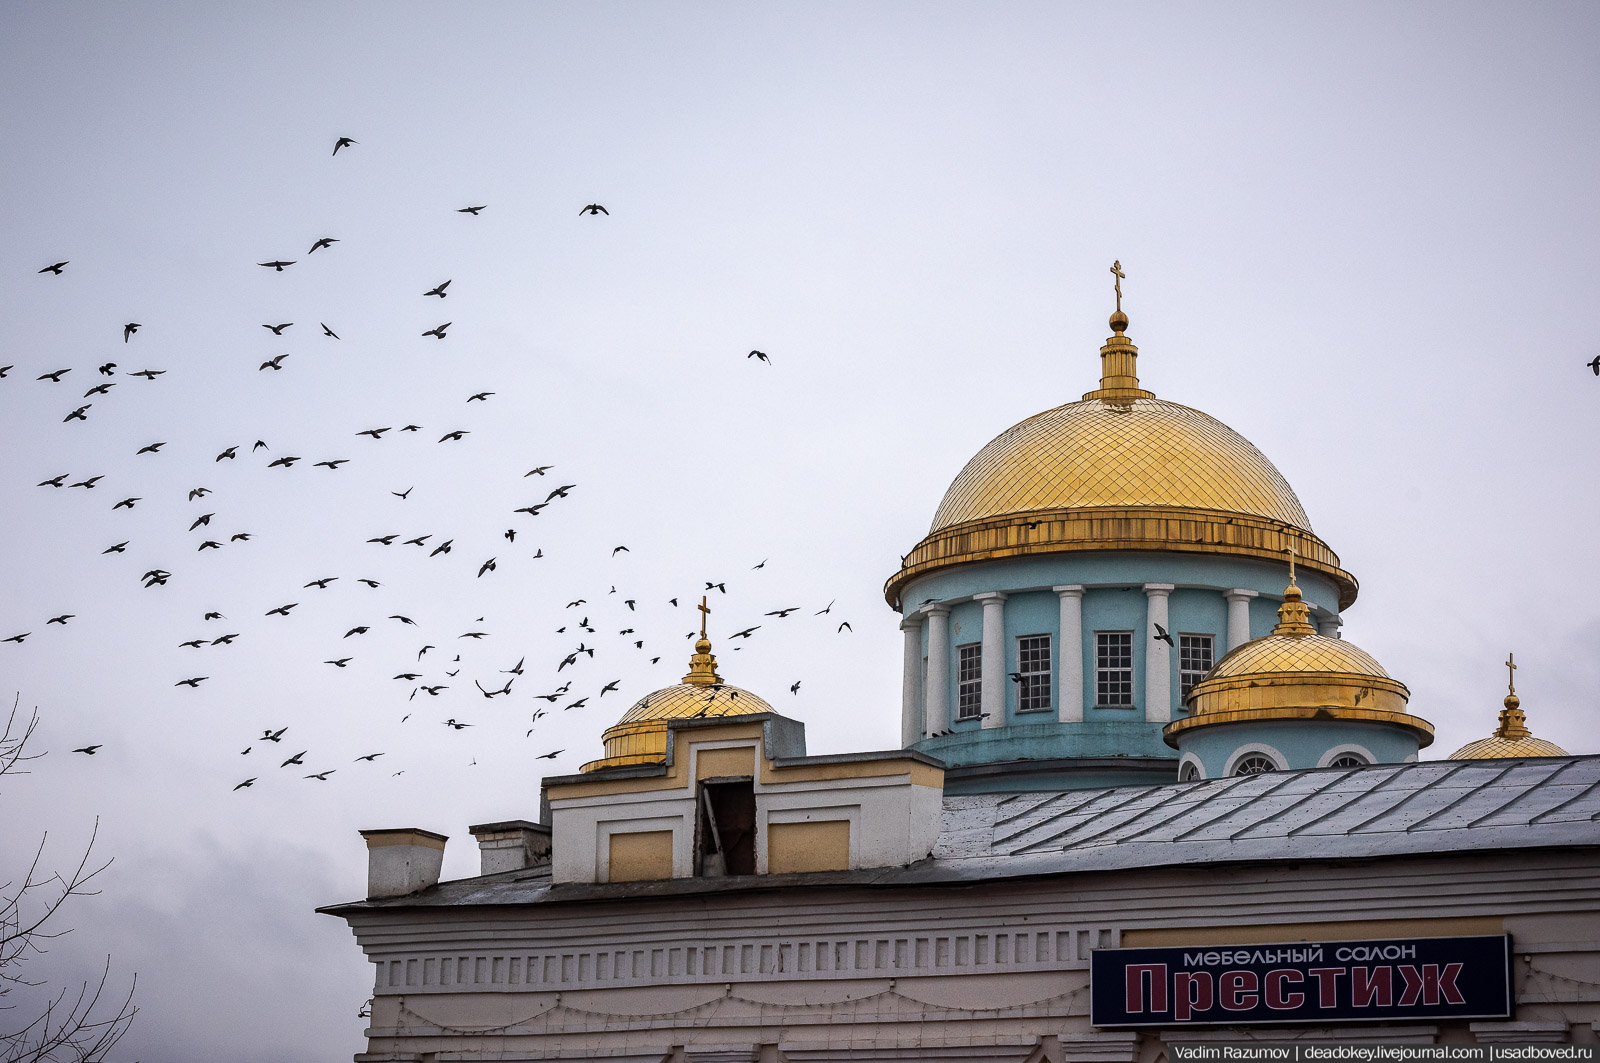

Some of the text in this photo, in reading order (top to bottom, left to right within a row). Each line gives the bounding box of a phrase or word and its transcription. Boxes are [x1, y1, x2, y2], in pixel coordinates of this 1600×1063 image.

[1184, 944, 1416, 966] мебельный салон
[1125, 963, 1466, 1021] Престиж
